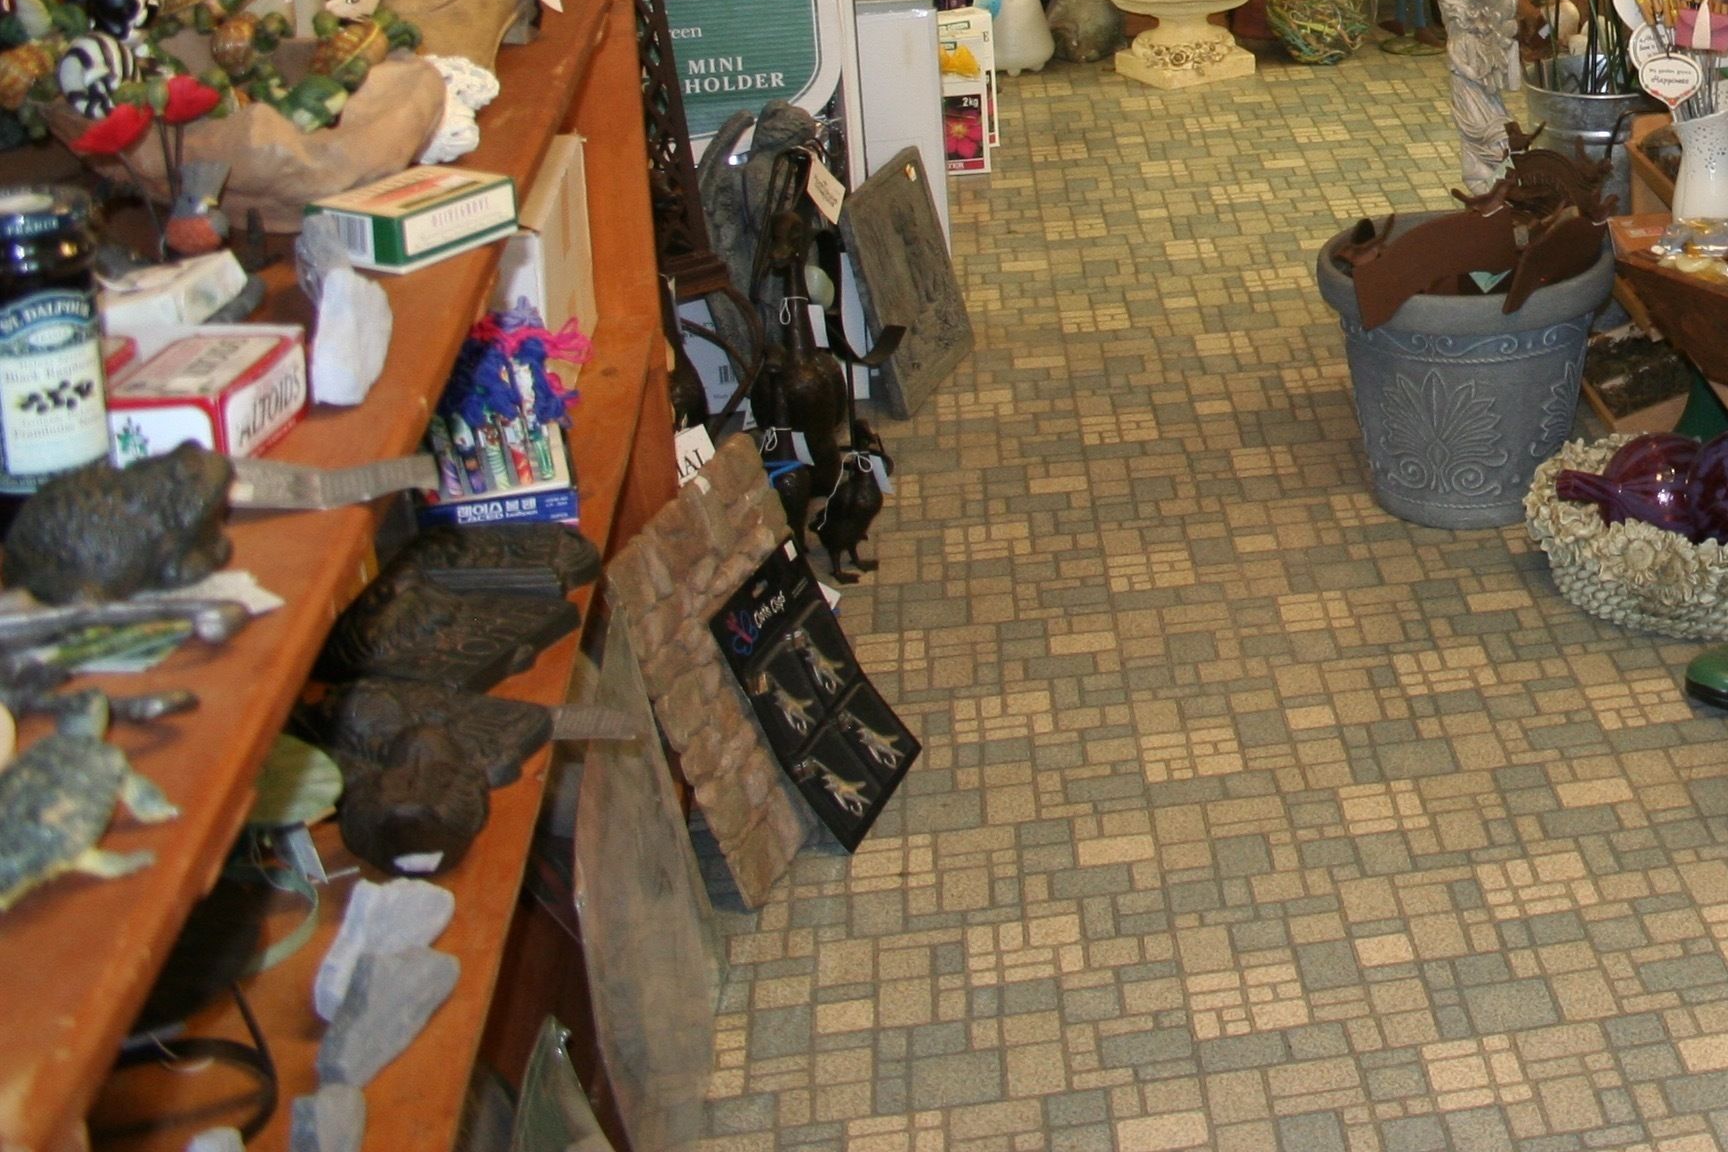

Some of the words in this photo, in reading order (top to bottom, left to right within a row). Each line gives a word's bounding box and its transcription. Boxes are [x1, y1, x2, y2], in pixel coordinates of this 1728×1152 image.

[688, 56, 743, 75] MINI
[684, 72, 785, 94] HOLDER
[962, 97, 979, 109] 2kg
[239, 368, 300, 448] ALTOIDS
